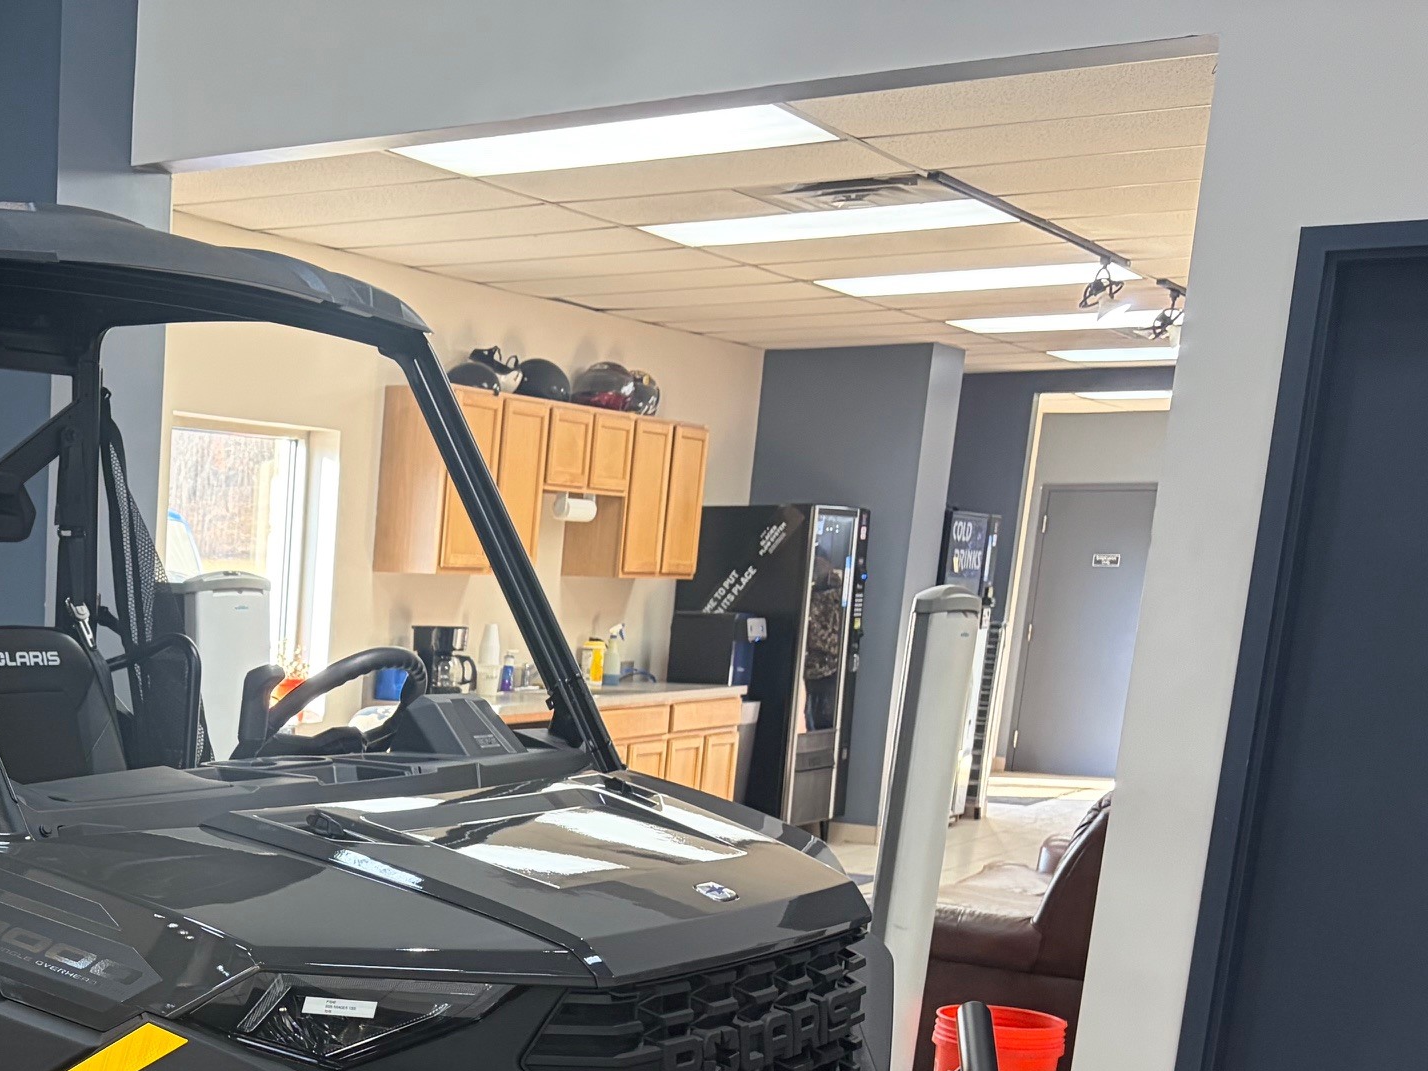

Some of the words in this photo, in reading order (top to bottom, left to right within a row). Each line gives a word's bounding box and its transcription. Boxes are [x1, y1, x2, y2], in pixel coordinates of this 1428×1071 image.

[953, 520, 973, 543] COLD
[714, 587, 726, 600] TO
[723, 569, 739, 590] PUT
[721, 591, 736, 609] ITS
[732, 565, 757, 596] PLACE
